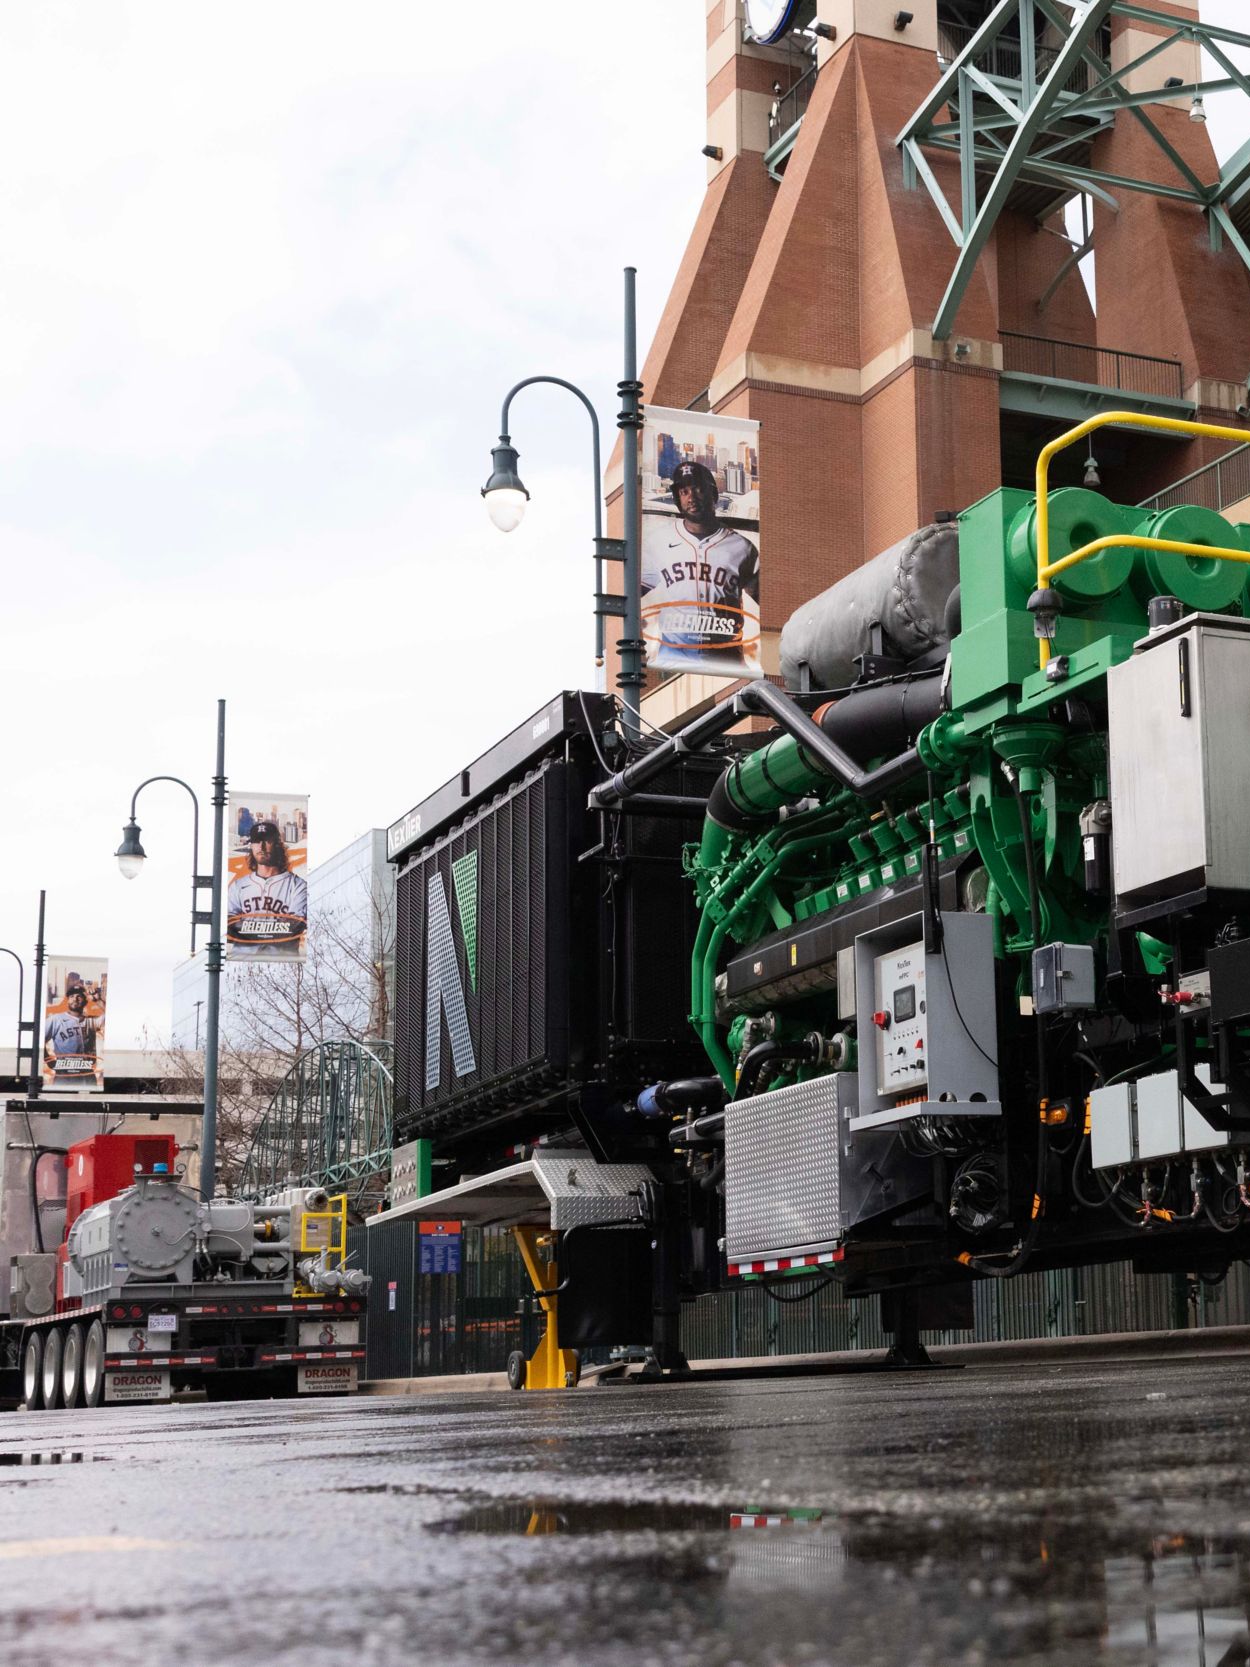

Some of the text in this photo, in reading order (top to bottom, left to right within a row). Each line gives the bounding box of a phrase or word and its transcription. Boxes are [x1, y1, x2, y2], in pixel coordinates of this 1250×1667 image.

[661, 561, 740, 594] ASTROS
[242, 896, 290, 914] STROS
[241, 921, 290, 933] RELENTLESS
[55, 1060, 93, 1069] RELENTLESS
[305, 1367, 351, 1378] DRAGON
[113, 1375, 162, 1386] DRAGON
